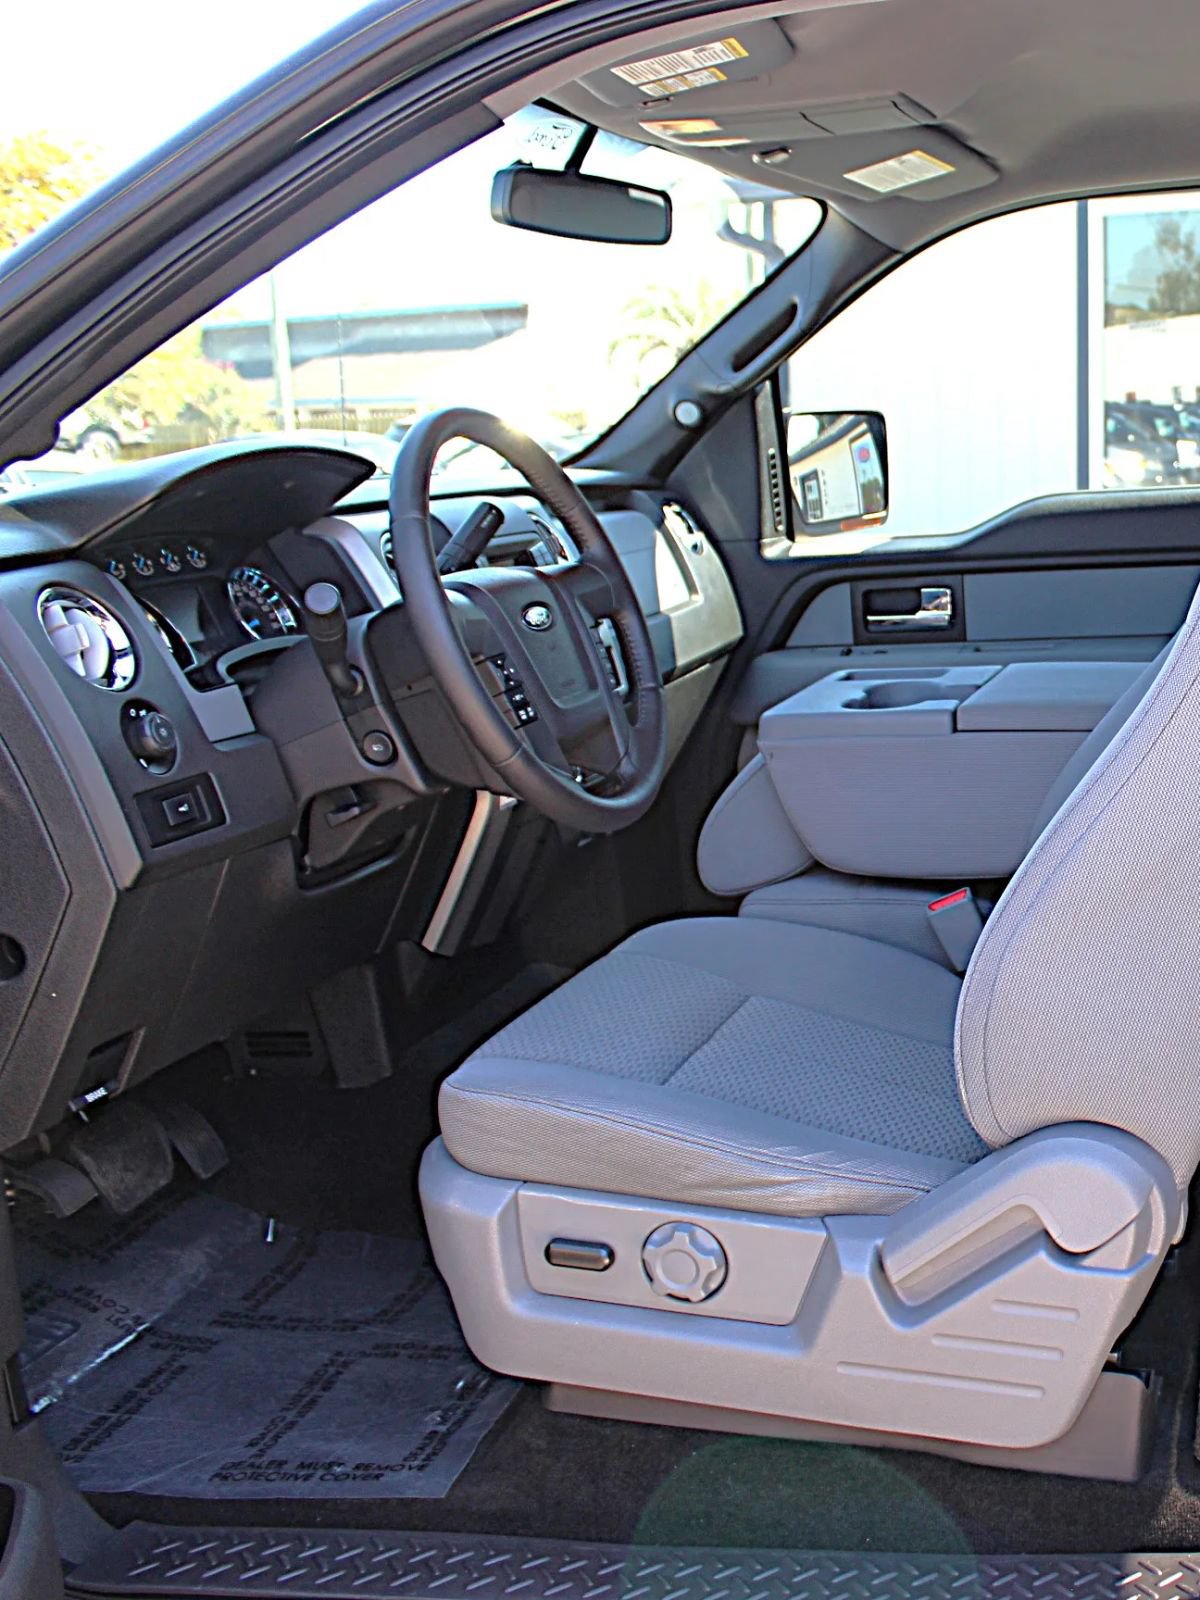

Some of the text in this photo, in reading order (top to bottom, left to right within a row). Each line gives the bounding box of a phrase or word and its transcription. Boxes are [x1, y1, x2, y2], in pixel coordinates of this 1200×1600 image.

[220, 1460, 430, 1472] DEALER MUST REMOVE
[208, 1471, 386, 1482] PROTECTIVE COVER
